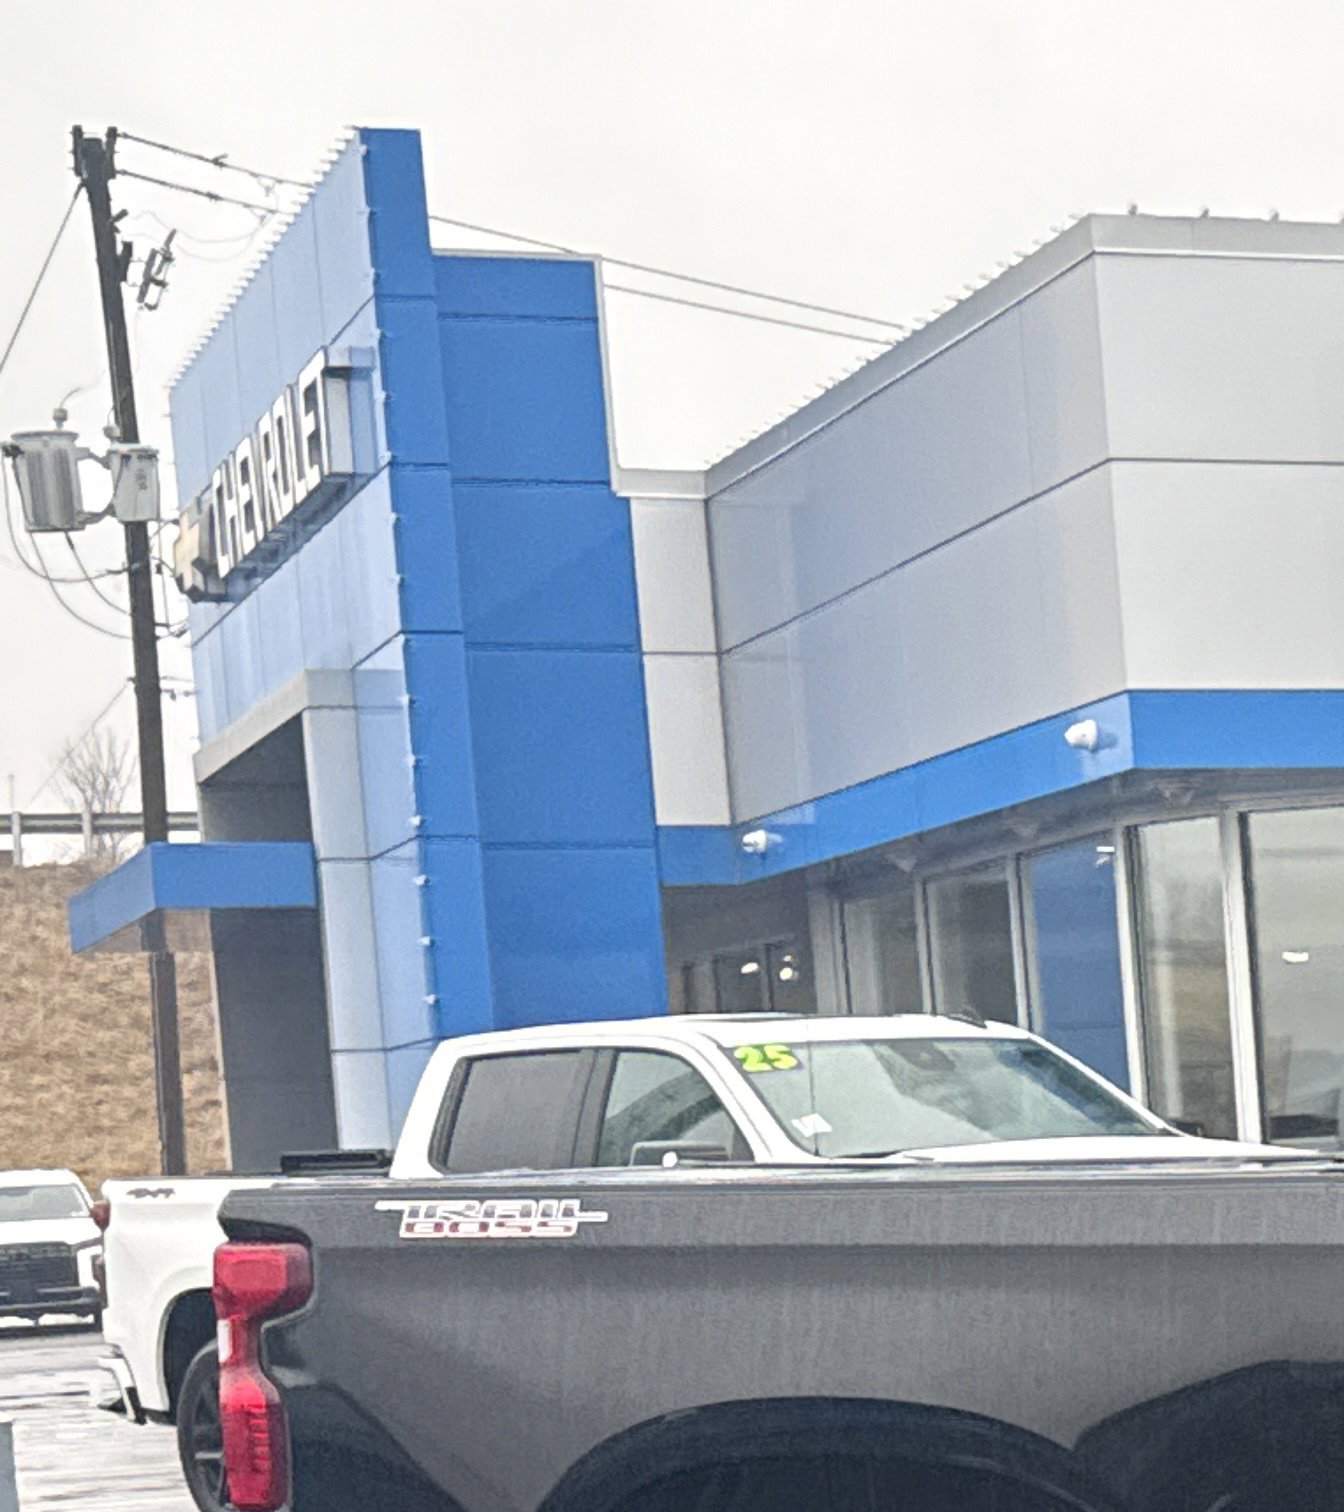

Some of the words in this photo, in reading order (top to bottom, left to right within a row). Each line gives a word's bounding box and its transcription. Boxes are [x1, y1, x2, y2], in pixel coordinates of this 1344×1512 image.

[211, 344, 331, 580] CHEVROLET
[732, 1044, 799, 1073] 25
[374, 1199, 609, 1221] TRAIL
[399, 1219, 580, 1239] BOSS
